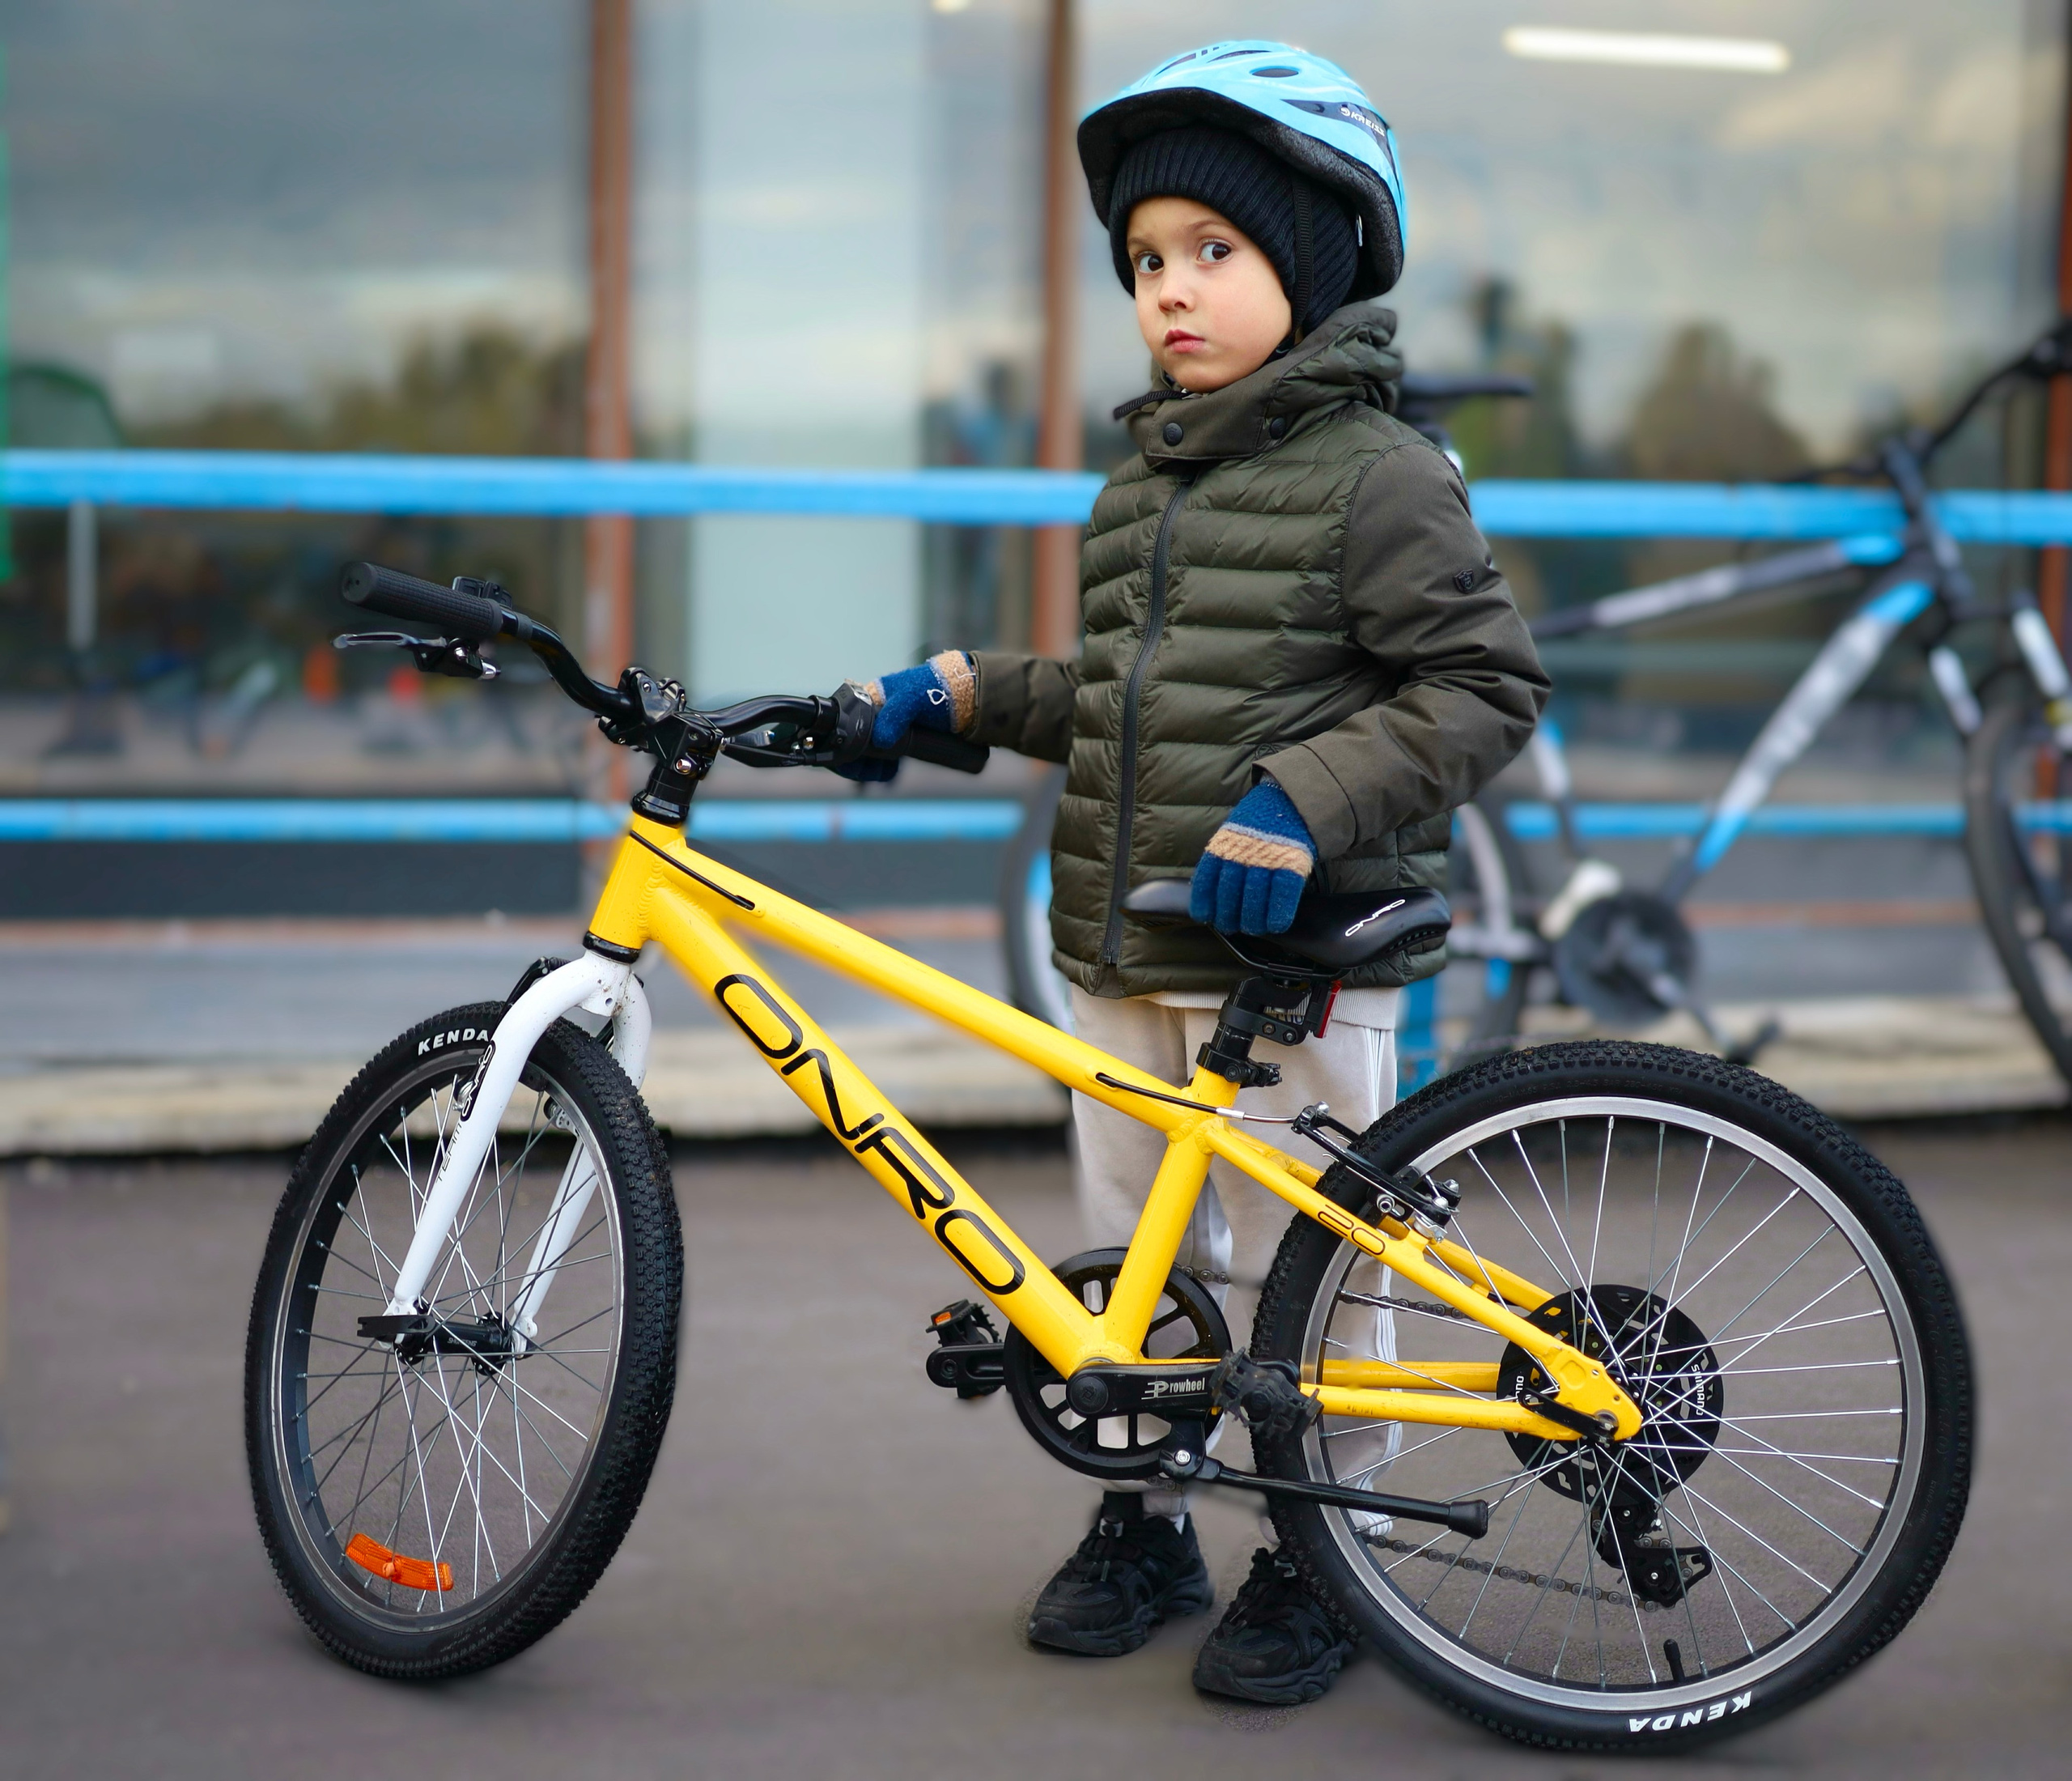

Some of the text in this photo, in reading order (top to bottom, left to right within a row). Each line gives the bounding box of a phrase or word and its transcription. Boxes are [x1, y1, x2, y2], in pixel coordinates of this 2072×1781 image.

[1351, 112, 1386, 137] KREISS
[1344, 899, 1406, 937] ONRO
[418, 1028, 489, 1056] KENDA
[435, 1123, 462, 1183] TEAM
[714, 973, 1025, 1295] ONRO
[1143, 1378, 1206, 1400] Prowheel
[1628, 1690, 1752, 1732] KENDA
